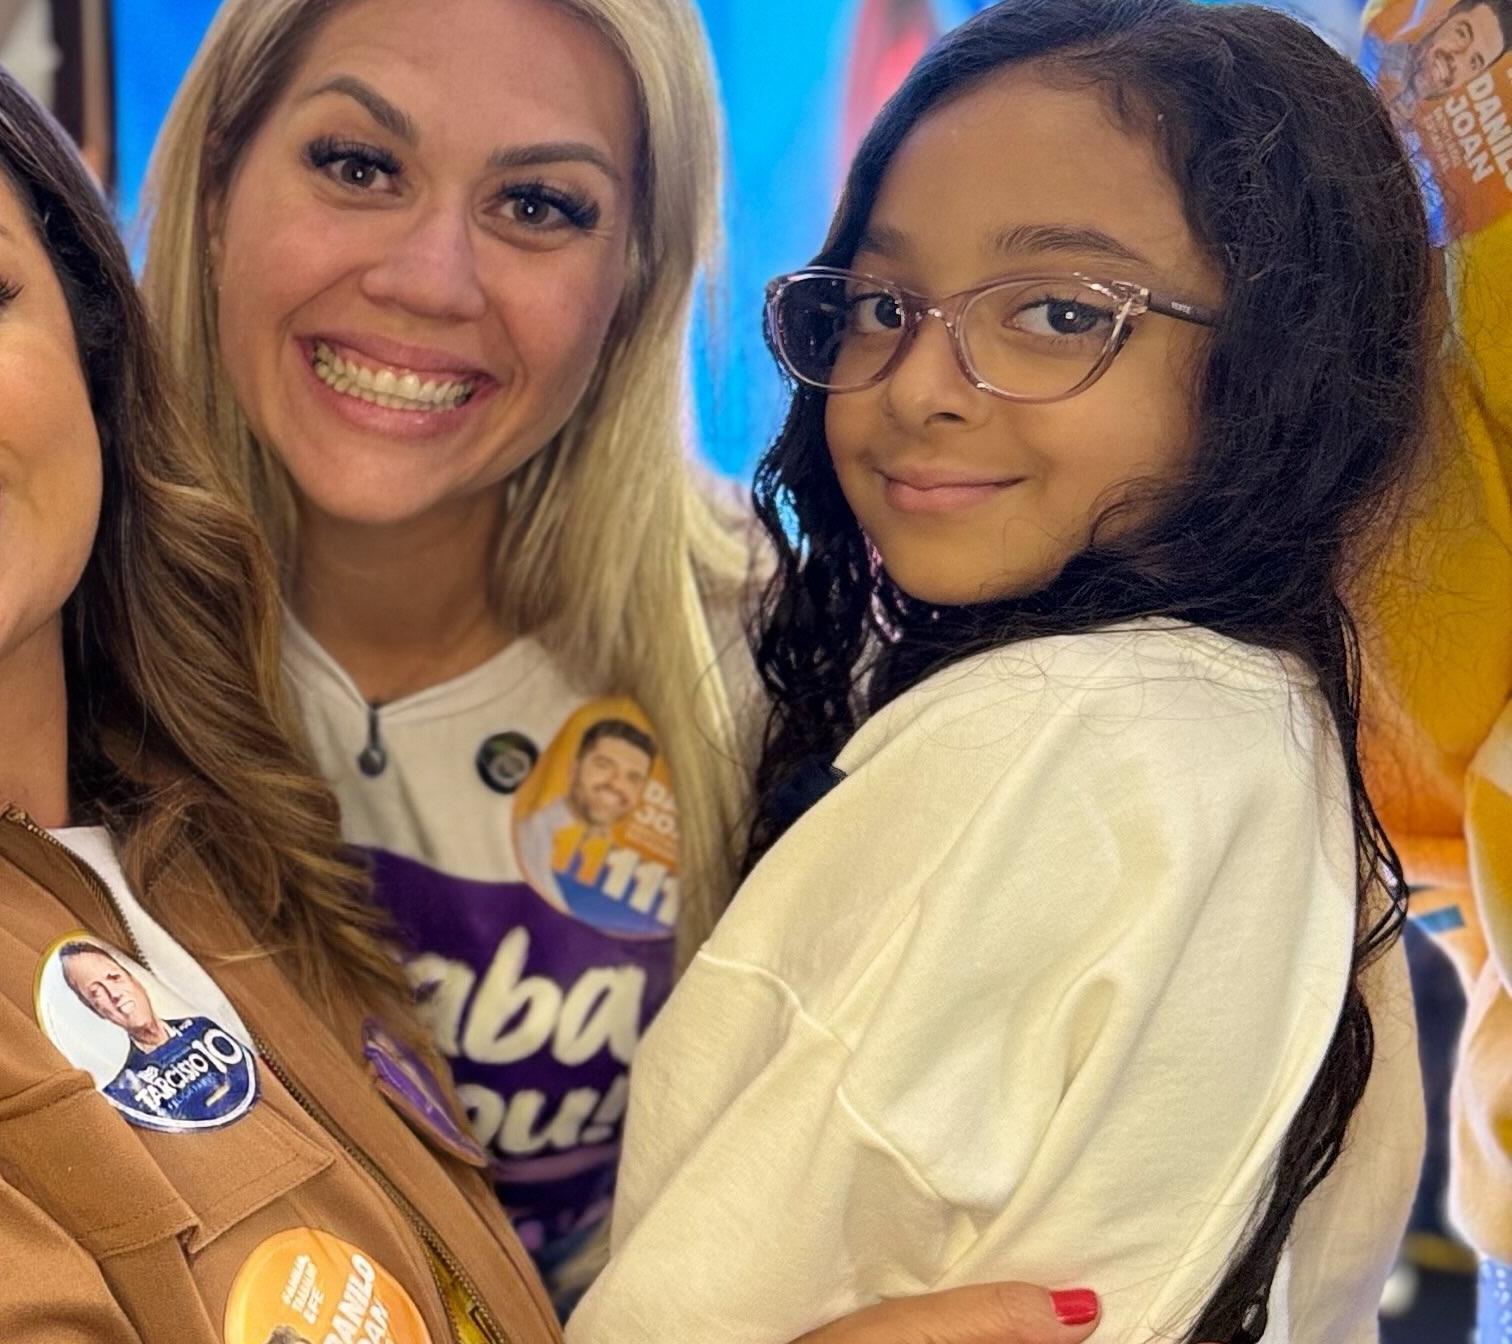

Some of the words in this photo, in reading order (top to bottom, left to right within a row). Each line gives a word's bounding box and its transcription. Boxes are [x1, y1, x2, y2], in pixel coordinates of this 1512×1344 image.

[1445, 93, 1495, 185] JOAN
[402, 924, 646, 1066] aba
[191, 1028, 244, 1074] 10
